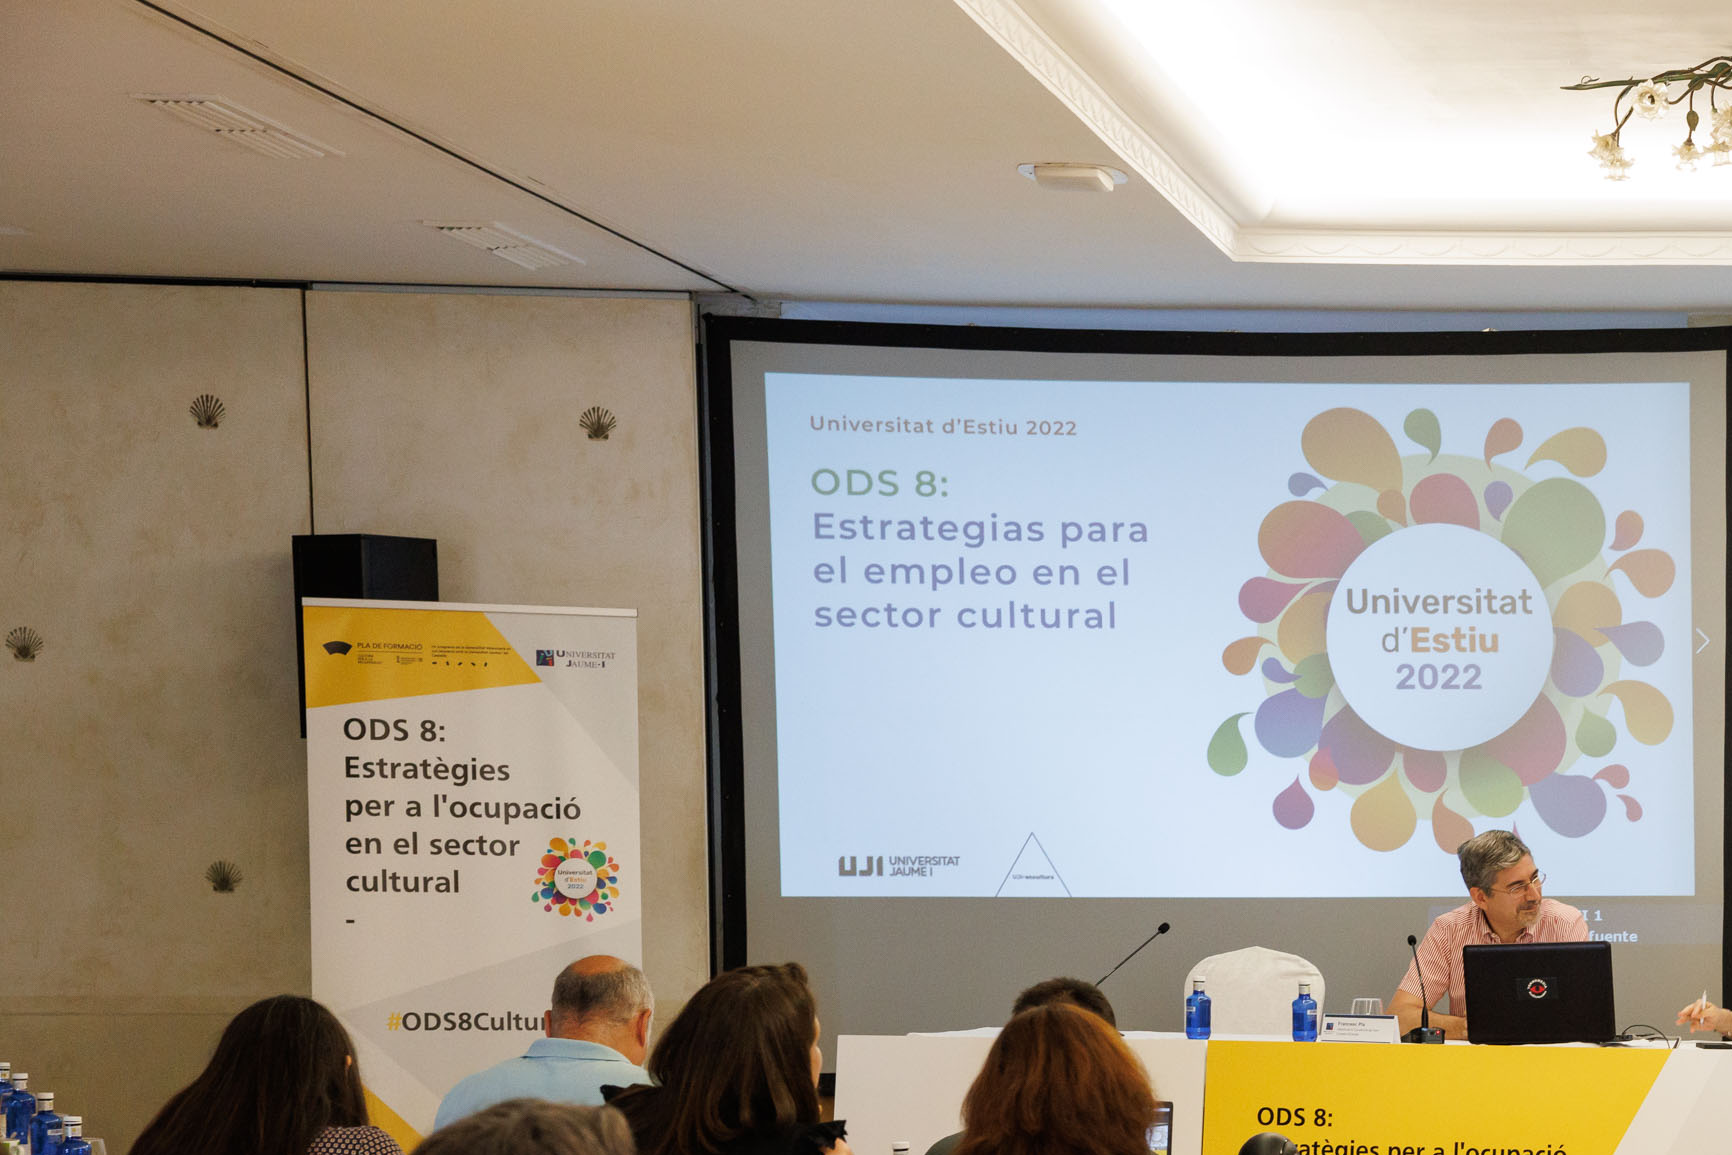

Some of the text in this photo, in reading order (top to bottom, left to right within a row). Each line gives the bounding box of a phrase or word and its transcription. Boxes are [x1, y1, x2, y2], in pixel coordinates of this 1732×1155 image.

[810, 415, 935, 434] Universitat
[1026, 420, 1077, 436] 2022
[811, 468, 949, 497] ODS 8:
[813, 512, 1149, 548] Estrategias para
[813, 556, 1130, 591] el empleo en el
[1346, 588, 1533, 616] Universitat
[813, 600, 1117, 630] sector cultural
[1395, 664, 1483, 691] 2022
[343, 717, 446, 742] ODS 8:
[344, 756, 511, 787] Estratègies
[345, 793, 582, 825] per a l'ocupació
[346, 832, 521, 857] en el sector
[838, 856, 960, 876] UJI UNIVERSITAT
[889, 866, 928, 877] JAUME
[346, 869, 460, 894] cultural
[1594, 909, 1603, 921] 1
[1588, 930, 1638, 943] fuente
[386, 1010, 546, 1032] #ODS8Cultur
[1257, 1107, 1333, 1127] ODS 8:
